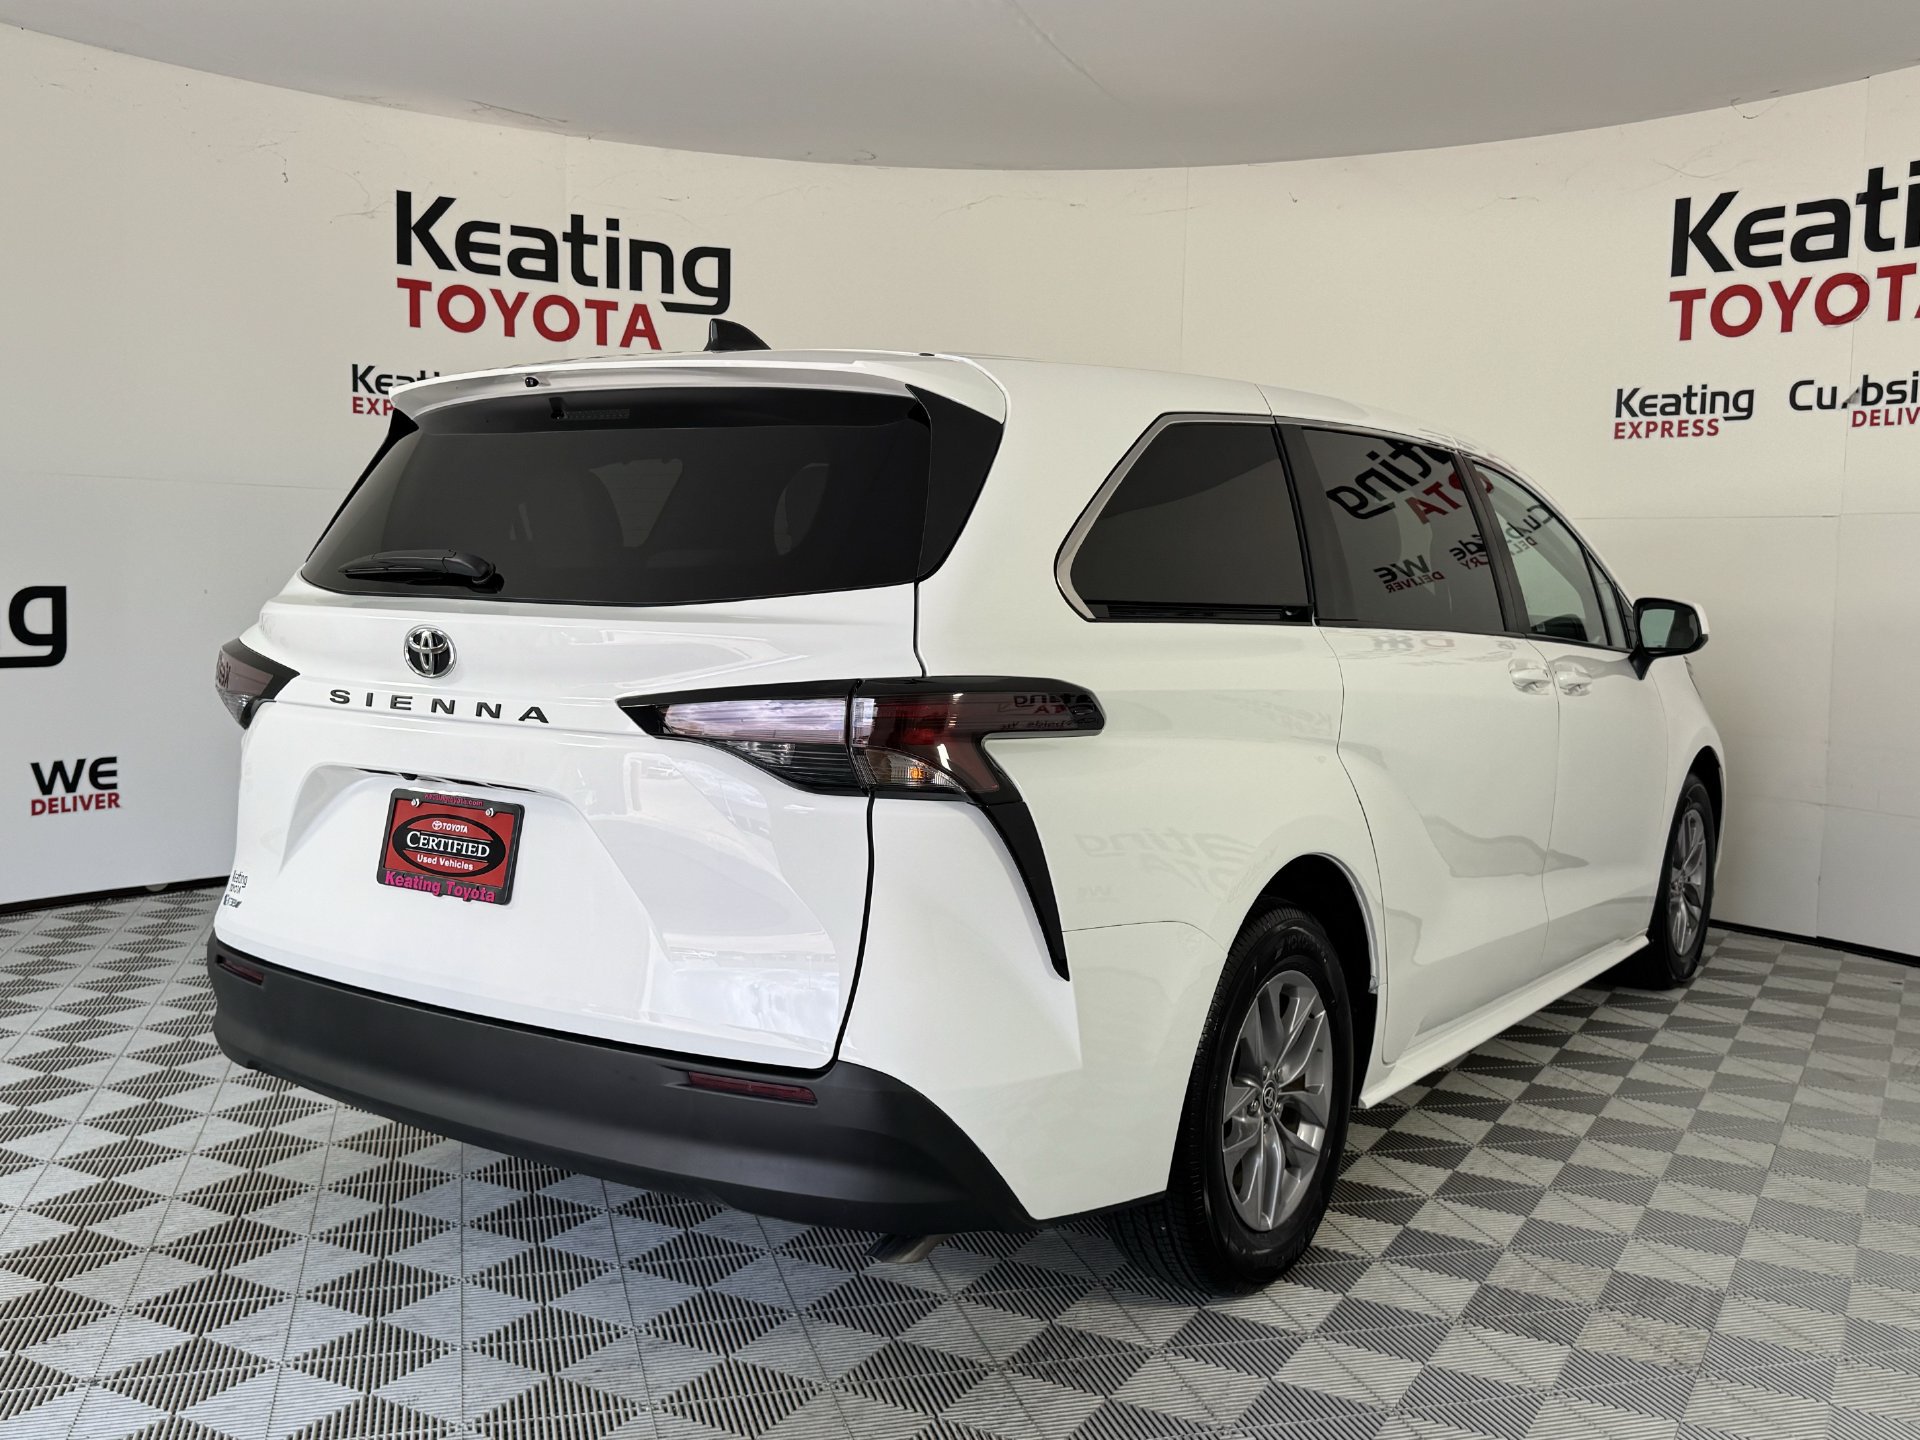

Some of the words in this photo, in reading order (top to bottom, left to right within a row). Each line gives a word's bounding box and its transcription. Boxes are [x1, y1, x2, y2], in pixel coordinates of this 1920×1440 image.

[396, 190, 732, 316] Keating
[396, 277, 663, 351] TOYOTA
[1669, 262, 1920, 342] TOYOT
[1615, 384, 1754, 421] Keating
[1789, 370, 1920, 411] Cubsi
[1613, 418, 1720, 440] EXPRESS
[329, 689, 549, 724] SIENNA
[31, 792, 121, 816] DELIVER
[406, 831, 490, 858] CERTIFIED
[442, 822, 468, 834] TOYOTA
[417, 854, 438, 865] Used
[439, 857, 474, 871] Vehicles
[385, 870, 442, 896] Keating
[446, 881, 496, 903] Toyota
